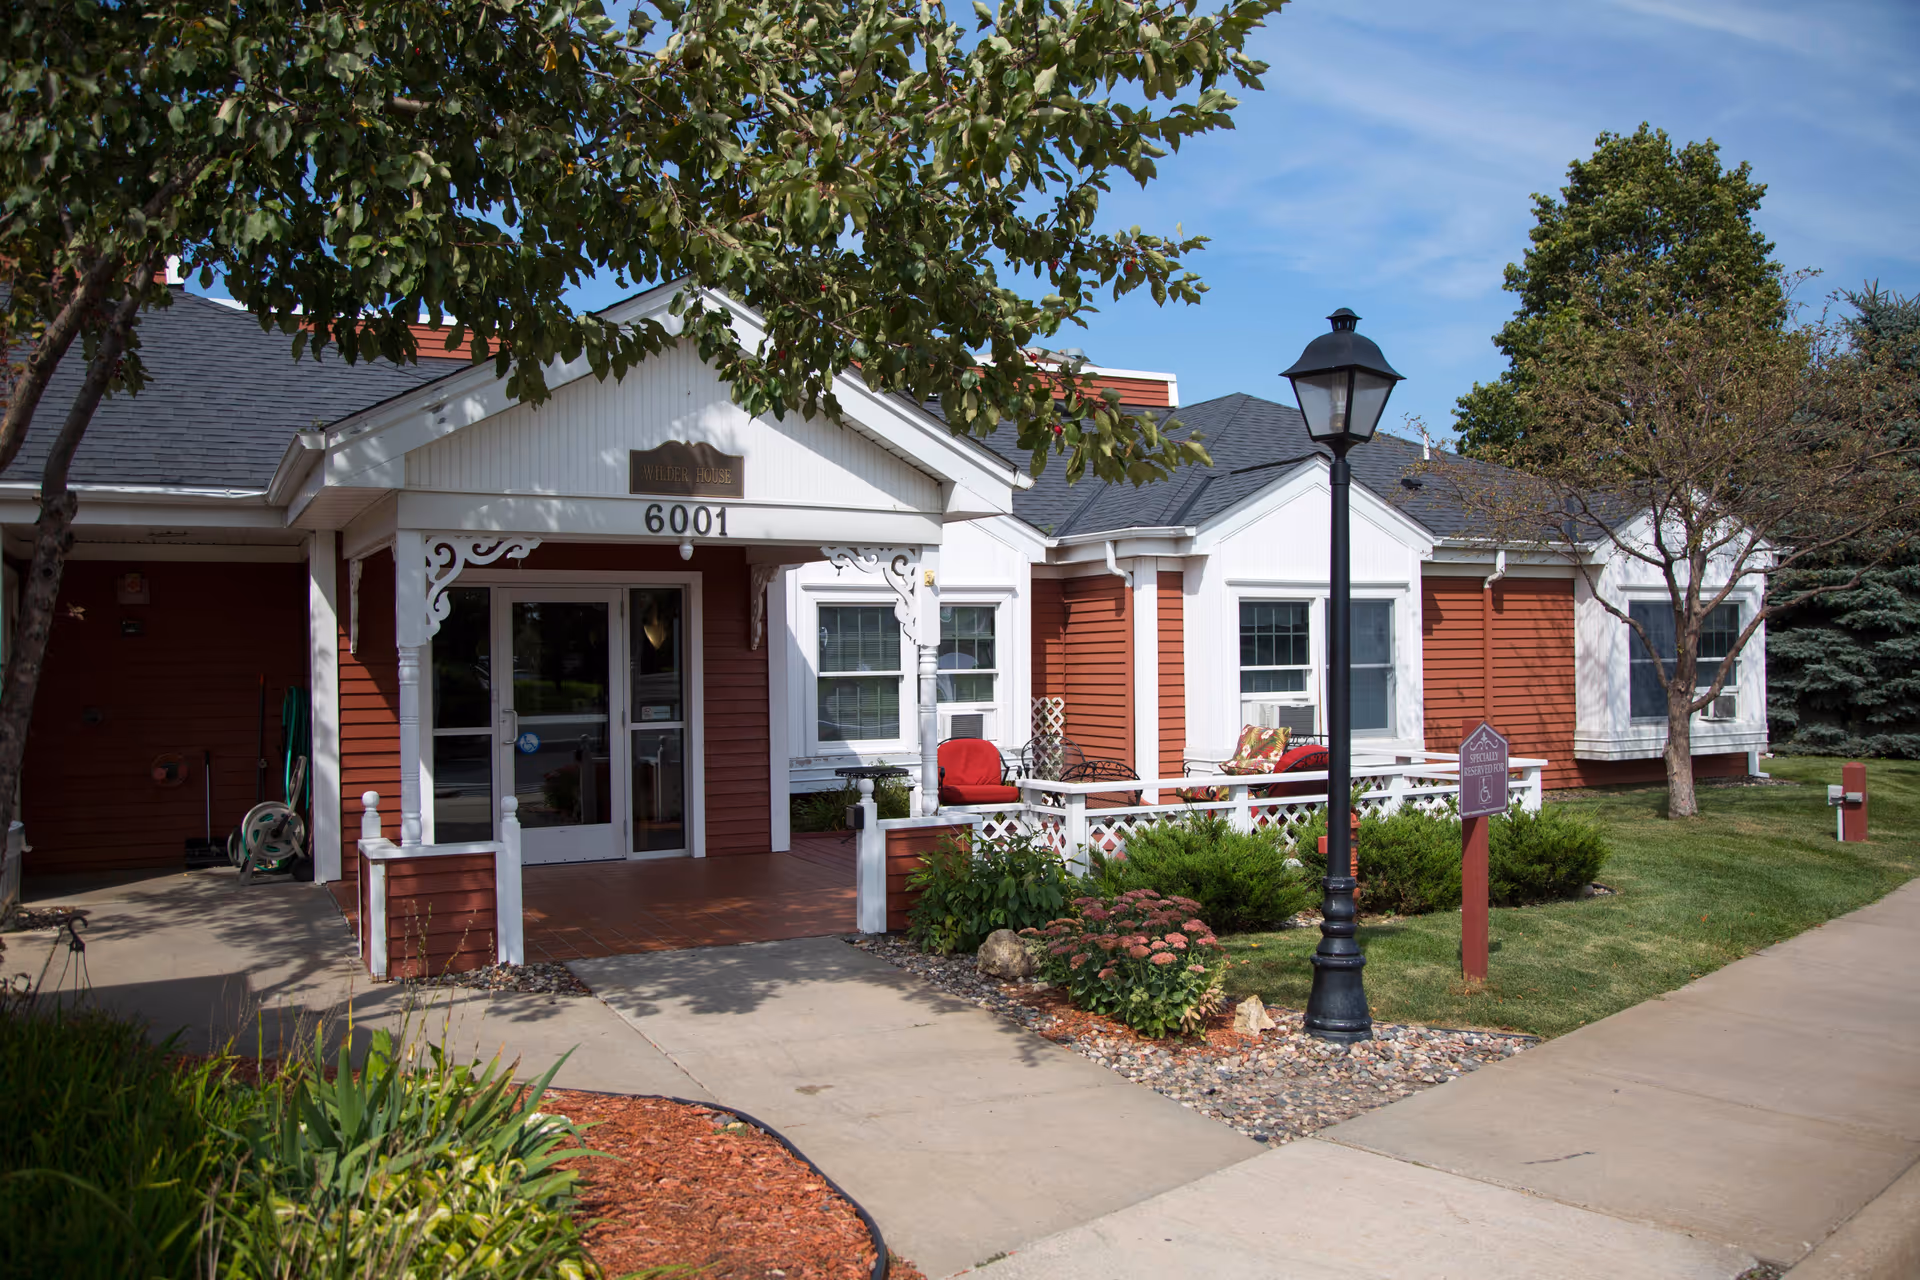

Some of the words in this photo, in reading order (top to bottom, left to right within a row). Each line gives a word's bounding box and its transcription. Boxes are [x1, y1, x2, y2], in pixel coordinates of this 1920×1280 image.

[642, 464, 688, 482] WILDER
[696, 467, 732, 484] HOUSE
[645, 503, 727, 536] 6001
[1469, 751, 1499, 764] SPECIALLY
[1463, 764, 1493, 776] RESERVED
[1493, 762, 1505, 773] FOR
